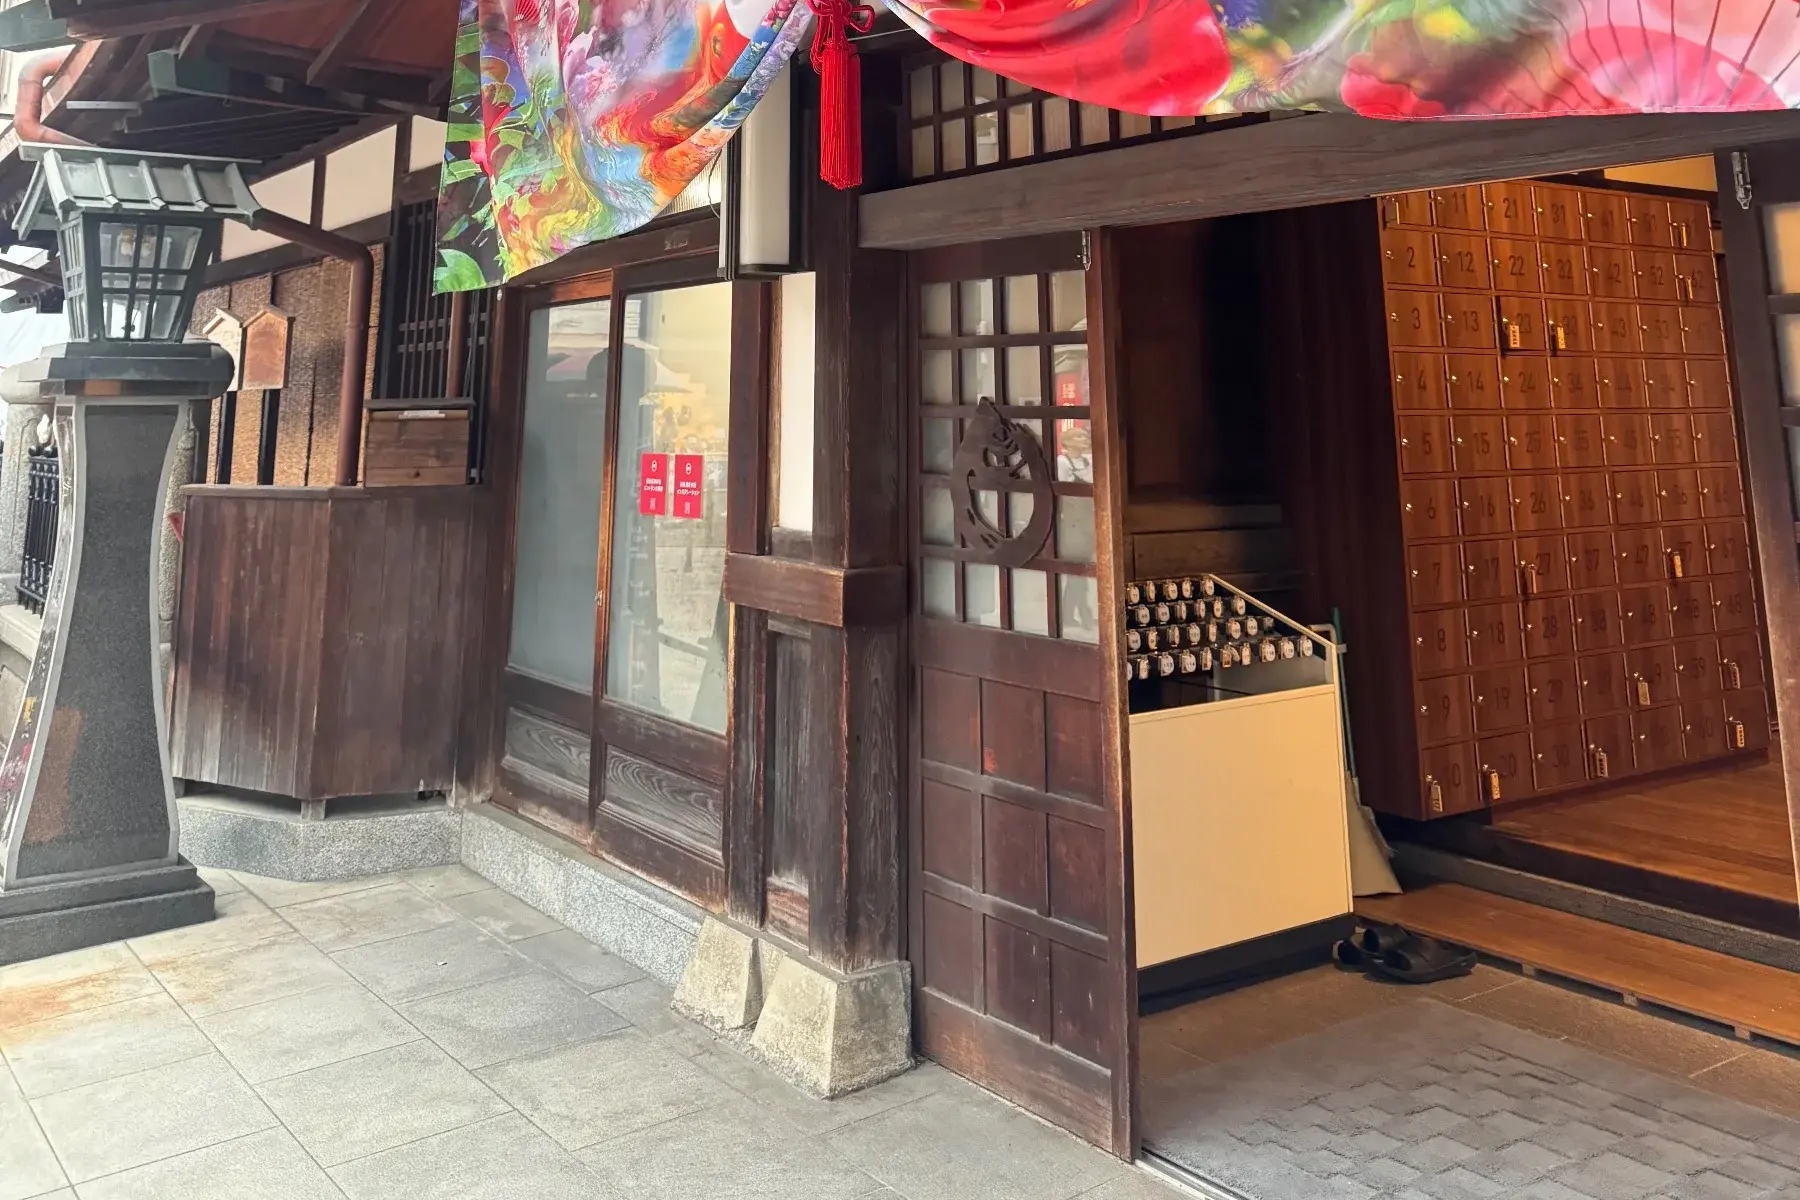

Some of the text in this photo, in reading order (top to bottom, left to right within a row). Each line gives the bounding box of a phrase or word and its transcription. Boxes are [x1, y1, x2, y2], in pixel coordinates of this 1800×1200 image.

[1503, 198, 1519, 219] 21
[1406, 246, 1416, 269] 2
[1456, 251, 1475, 273] 12
[1508, 255, 1526, 277] 22
[1411, 307, 1421, 330] 3
[1462, 310, 1480, 333] 13
[1418, 369, 1428, 392] 4
[1467, 370, 1485, 394] 14
[1518, 371, 1537, 394] 24
[1422, 432, 1432, 455] 5
[1473, 432, 1490, 455] 15
[1525, 430, 1542, 454] 25
[1427, 495, 1436, 520] 6
[1480, 493, 1496, 517] 16
[1529, 490, 1545, 514] 26
[1432, 562, 1441, 586] 7
[1484, 556, 1500, 580] 17
[1536, 552, 1552, 576] 27
[1437, 628, 1447, 653] 8
[1489, 620, 1505, 645] 18
[1441, 694, 1451, 720] 9
[1494, 686, 1510, 711] 19
